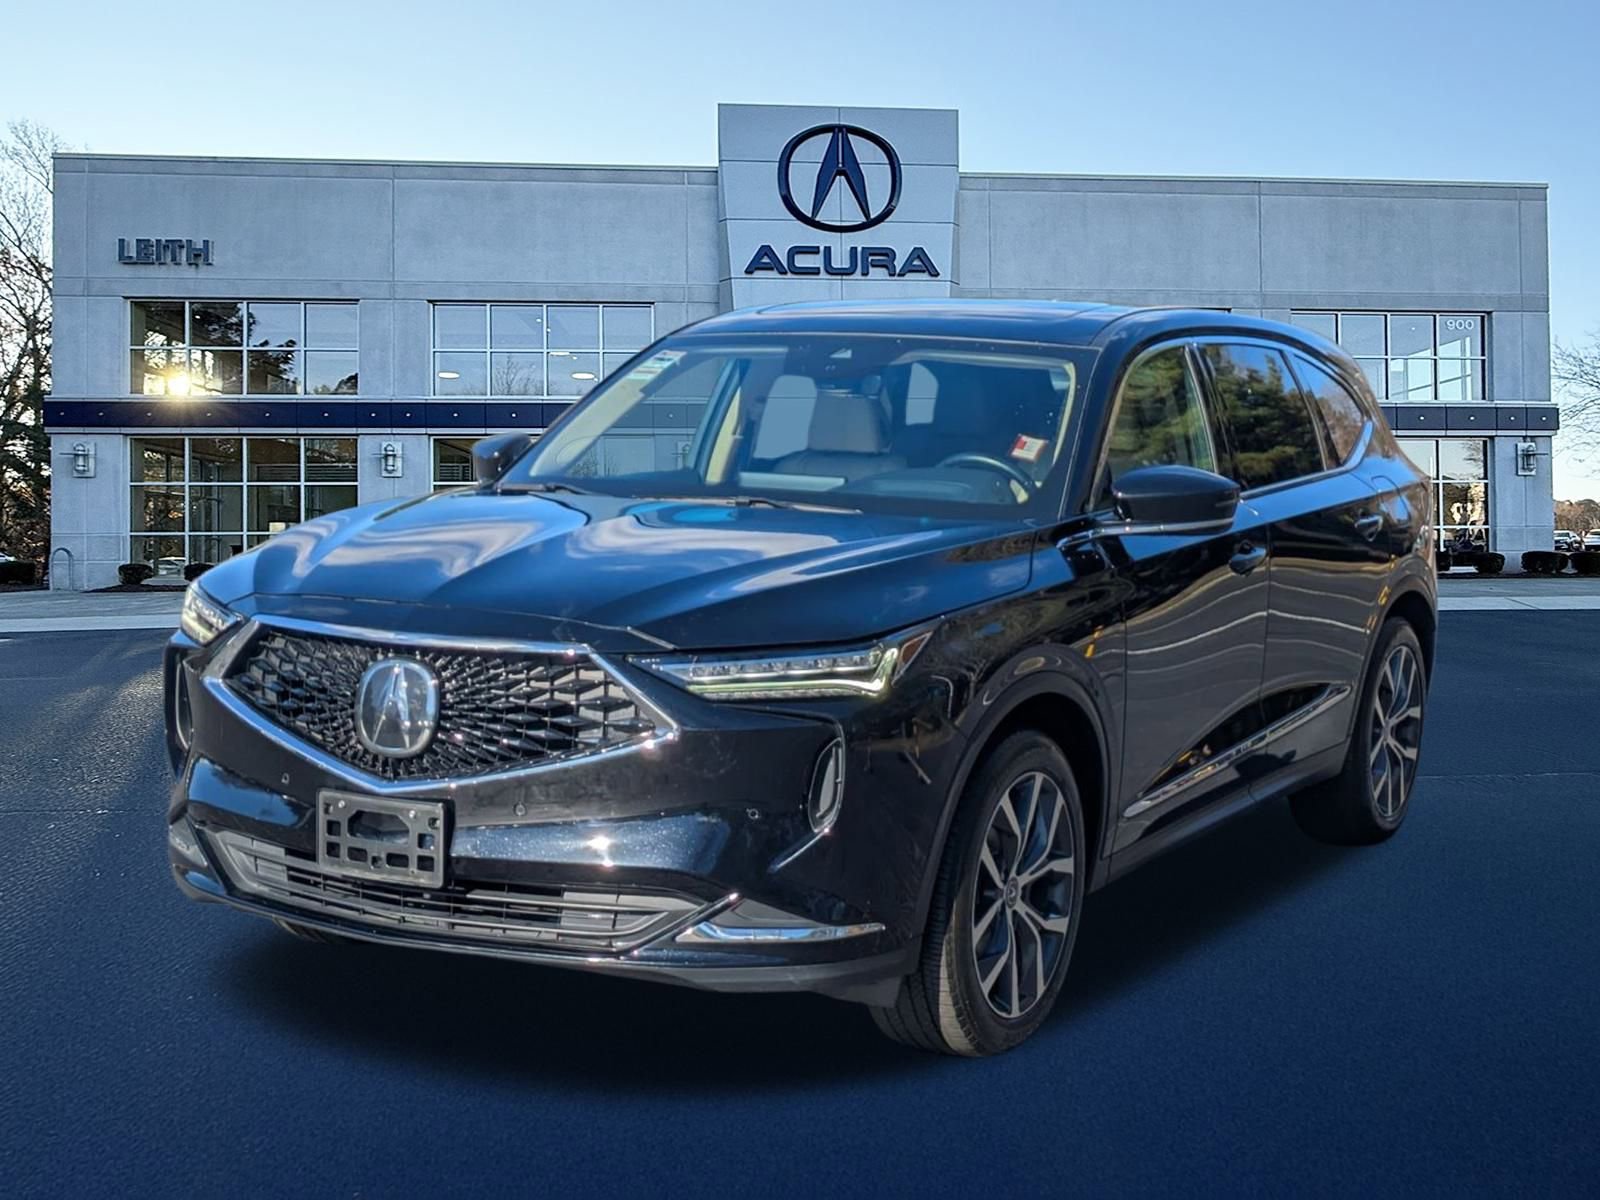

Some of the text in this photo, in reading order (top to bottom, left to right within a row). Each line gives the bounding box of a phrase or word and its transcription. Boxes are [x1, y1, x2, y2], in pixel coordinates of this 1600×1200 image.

[118, 238, 212, 265] LEITH
[744, 244, 940, 277] ACURA
[1446, 319, 1474, 330] 900
